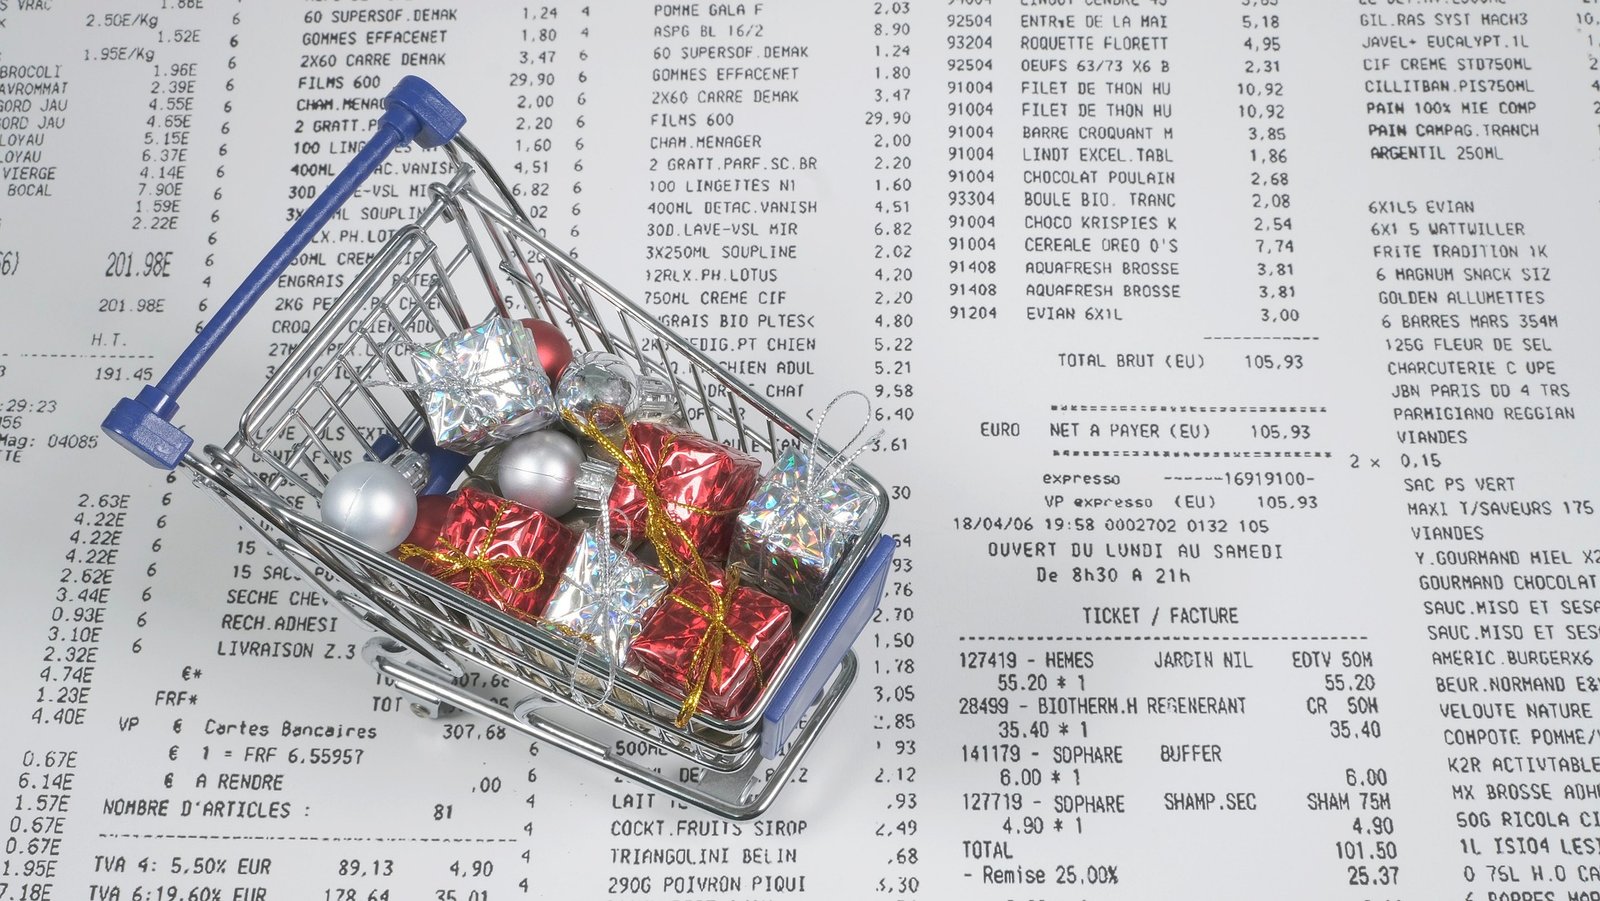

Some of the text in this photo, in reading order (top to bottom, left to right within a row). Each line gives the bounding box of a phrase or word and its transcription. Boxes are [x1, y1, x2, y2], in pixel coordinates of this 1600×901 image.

[86, 14, 158, 29] 2.50E/Kg
[304, 7, 557, 23] 60 SUPERSOF.DEMAK 1,24
[947, 36, 1280, 51] 93204 ROQUETTE FLORETT 4,95
[85, 47, 154, 62] 1.95E/Kg
[155, 63, 197, 76] 1.96E
[948, 59, 1279, 73] 92504 OEUFS 63/73 X6 B 2,31
[1364, 58, 1531, 71] CIF CREME STD750ML
[354, 76, 380, 88] 600
[510, 73, 554, 86] 29,90
[653, 67, 798, 81] GOMMES EFFACENET
[151, 81, 195, 94] 2.39E
[948, 81, 1283, 96] 91004 FILET DE THON HU 10,92
[1367, 102, 1404, 114] PAIN
[1499, 101, 1536, 114] COMP
[707, 113, 733, 126] 600
[949, 126, 1286, 140] 91004 BARRE CROQUANT M 3,85
[4, 166, 185, 180] VIERGE 4.14E
[949, 170, 1288, 186] 91004 CHOCOLAT POULAIN 2,68
[139, 183, 182, 196] 7.90E
[705, 201, 816, 214] DETAC.VANISH
[1426, 200, 1474, 213] EVIAN
[722, 245, 796, 258] SOUPLINE
[106, 252, 173, 277] 201.98E
[950, 261, 1293, 276] 91408 AQUAFRESH BROSSE 3,81
[701, 291, 747, 305] CREME
[759, 291, 786, 304] CIF
[1379, 291, 1544, 304] GOLDEN ALLUMETTES
[99, 299, 164, 312] 201.98E
[950, 306, 1299, 322] 91204 EVIAN 6X1L 3,00
[1382, 315, 1558, 328] 6 BARRES MARS 354M
[92, 333, 126, 346] H.T.
[1386, 338, 1551, 351] 125G FLEUR DE SEL
[1058, 353, 1106, 367] TOTAL
[1117, 354, 1154, 367] BRUT
[1166, 354, 1204, 368] (EU)
[96, 368, 152, 380] 191.45
[1394, 407, 1575, 420] PARMIGIANO REGGIAN
[981, 422, 1020, 436] EURO
[1050, 423, 1079, 437] NET
[1090, 424, 1100, 436] A
[1111, 424, 1159, 438] PAYER
[1170, 424, 1209, 438] (EU)
[1397, 430, 1467, 444] VIANDES
[1401, 453, 1441, 468] 0,15
[1404, 477, 1514, 492] SAC PS VERT
[78, 494, 130, 508] 2.63E
[1408, 500, 1594, 516] MAXI T/SAVEURS 175
[74, 512, 126, 527] 4.22E
[954, 517, 1269, 533] 18/04/06 19:58 0002702 0132 105
[1411, 526, 1484, 540] VIANDES
[989, 542, 1282, 559] OUVERT DU LUNDI AU SAMEDI
[1037, 567, 1190, 584] De 8h30 A 21h
[56, 587, 110, 603] 3.44E
[227, 589, 278, 604] SECHE
[222, 614, 337, 632] RECH.ADHESI
[1083, 607, 1140, 624] TICKET
[1171, 607, 1239, 624] FACTURE
[48, 626, 102, 642] 3.10E
[44, 646, 98, 662] 2.32E
[218, 641, 355, 659] LIVRAISON Z.3
[1325, 674, 1375, 691] 55.20
[1440, 703, 1592, 718] VELOUTE NATURE
[119, 717, 139, 731] VP
[205, 719, 269, 736] Cartes
[282, 720, 376, 739] Bancaires
[23, 751, 77, 768] 0.67E
[19, 772, 74, 791] 6.14E
[1346, 768, 1387, 786] 6.00
[103, 798, 452, 820] NOMBRE D'ARTICLES 81
[754, 820, 807, 836] SIROP
[963, 840, 1397, 859] TOTAL 101.50
[95, 856, 126, 872] TVA
[171, 857, 226, 874] 5,50%
[238, 858, 271, 874] EUR
[339, 859, 393, 877] 89,13
[450, 860, 493, 877] 4,90
[664, 876, 740, 893] POIVRON
